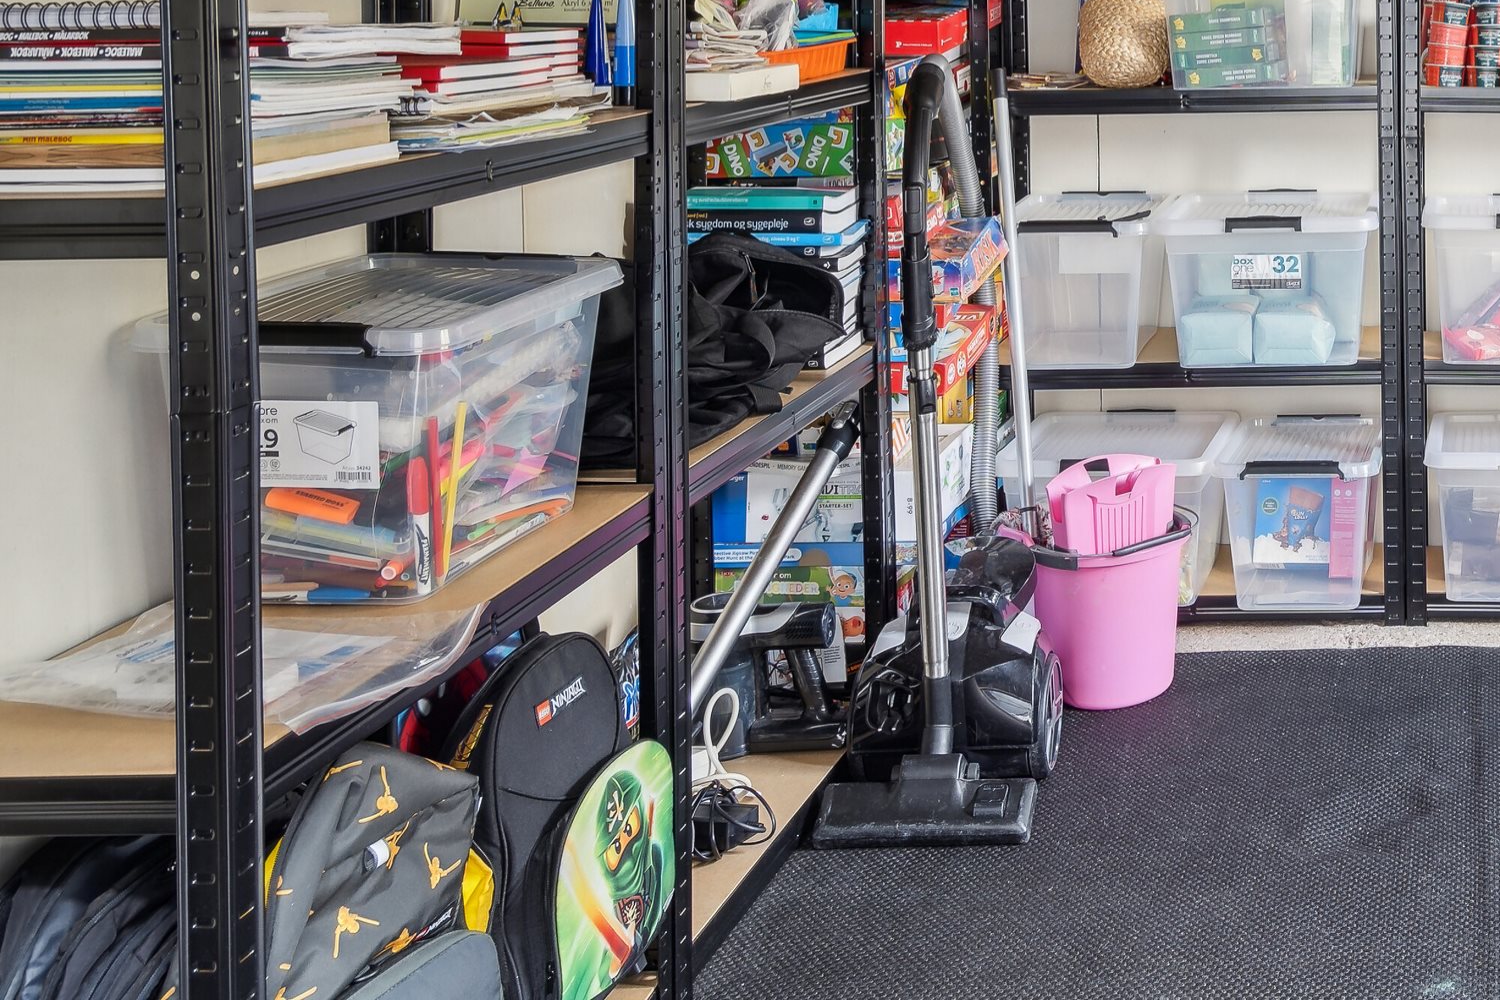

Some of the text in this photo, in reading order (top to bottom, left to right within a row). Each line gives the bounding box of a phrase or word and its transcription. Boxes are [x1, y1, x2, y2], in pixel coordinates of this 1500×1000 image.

[561, 0, 579, 8] Akryl
[580, 0, 587, 7] 6
[723, 143, 745, 177] DINO
[806, 135, 827, 169] DINO
[695, 218, 732, 231] sygdom
[733, 220, 746, 230] og
[746, 218, 789, 230] sygepleje
[1232, 265, 1254, 273] one
[1272, 255, 1299, 274] 32
[418, 537, 432, 583] PERMANENT
